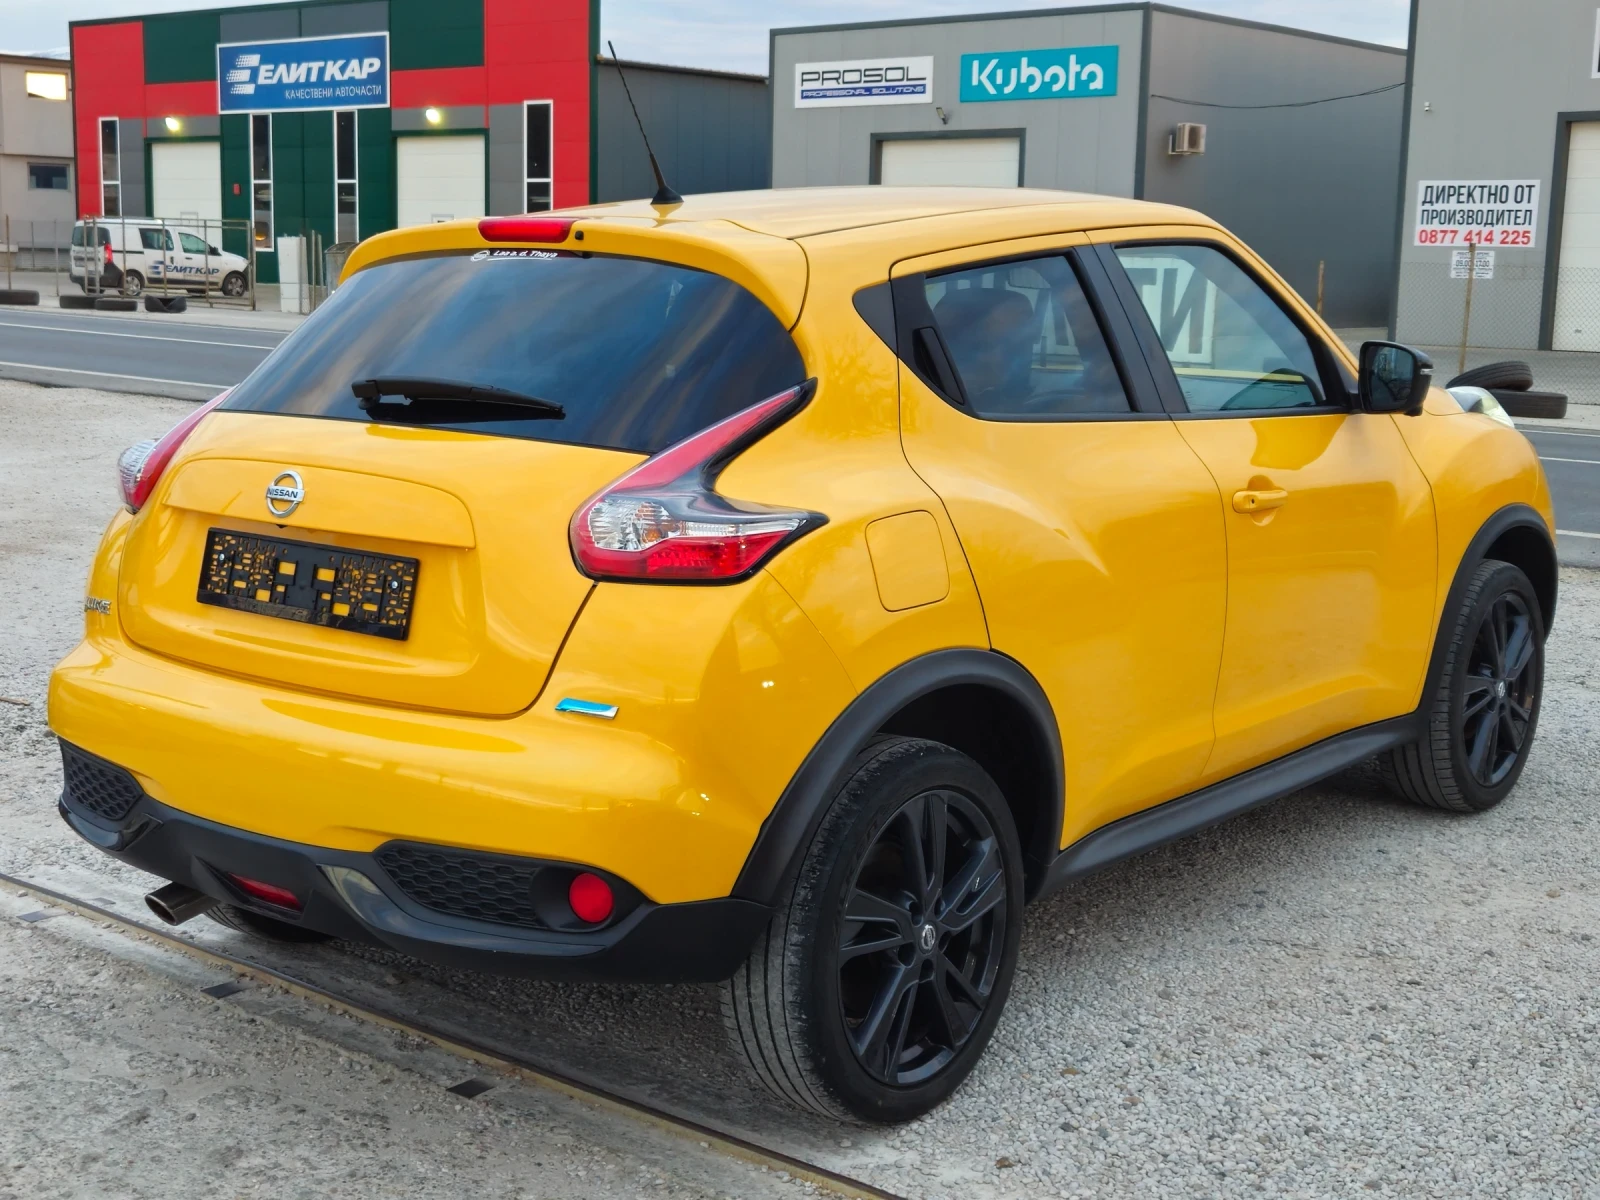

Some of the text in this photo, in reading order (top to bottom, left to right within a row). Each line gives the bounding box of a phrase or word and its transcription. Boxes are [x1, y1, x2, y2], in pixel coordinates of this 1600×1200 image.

[801, 66, 927, 87] PROSOL
[971, 53, 1104, 95] Kubota
[285, 84, 382, 100] КАЧЕСТВЕНИ АВТОЧАСТИ
[803, 85, 925, 98] PROFESSIONAL SOLUTIONS
[1421, 184, 1536, 207] ДИРЕКТНО ОТ
[1420, 209, 1533, 228] ПРОИЗВОДИТЕЛ
[1418, 229, 1532, 245] 0877 414 225
[267, 487, 299, 499] NISSAN
